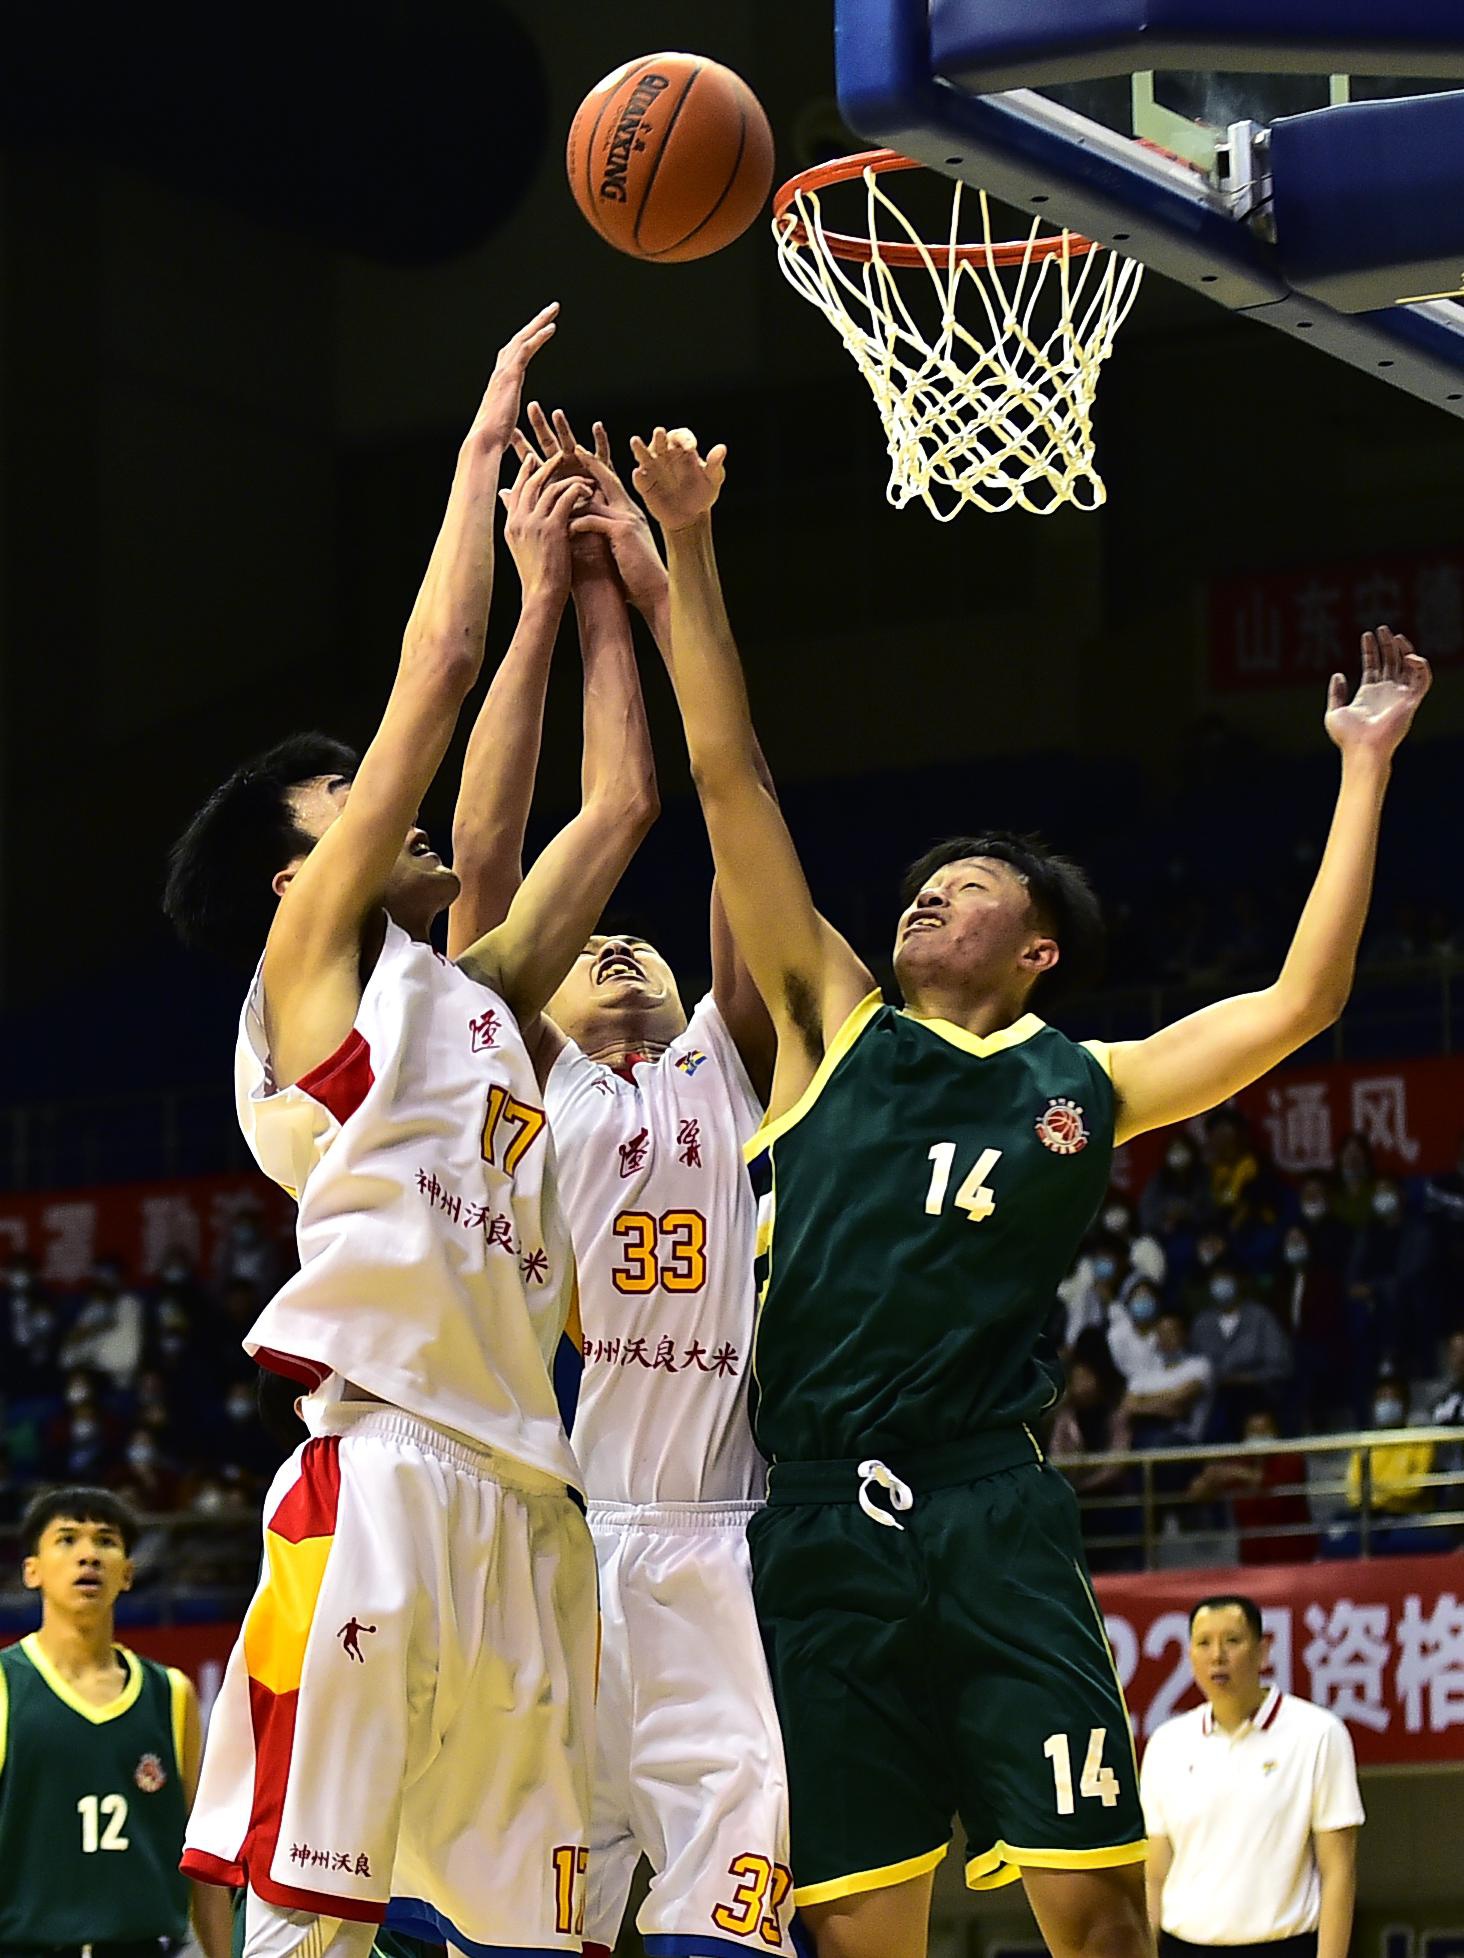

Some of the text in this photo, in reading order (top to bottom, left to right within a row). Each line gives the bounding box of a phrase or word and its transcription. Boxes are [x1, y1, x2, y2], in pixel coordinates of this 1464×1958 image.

[481, 1083, 546, 1178] 17
[925, 1142, 1003, 1222] 14
[415, 1167, 549, 1284] 神州沃良米
[612, 1209, 707, 1295] 33
[1043, 1727, 1120, 1815] 14
[77, 1793, 131, 1854] 12
[290, 1843, 372, 1878] 神州沃良
